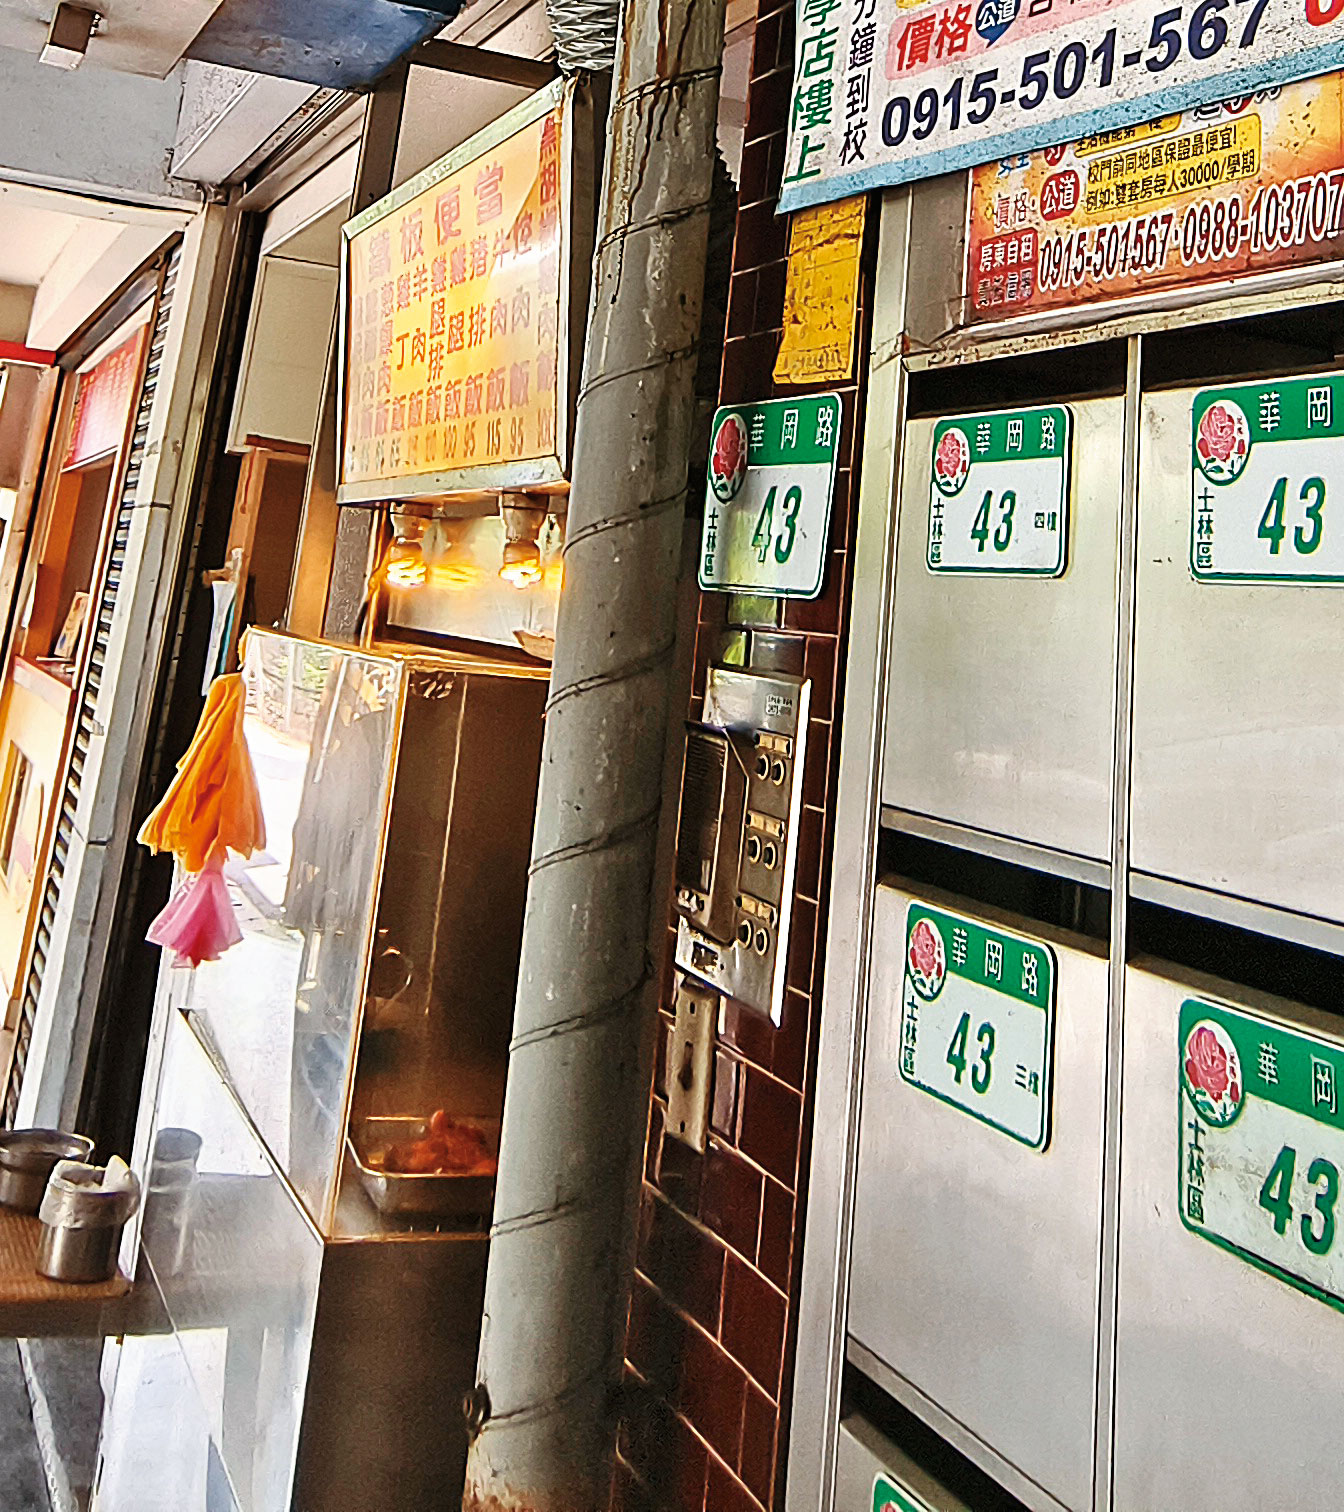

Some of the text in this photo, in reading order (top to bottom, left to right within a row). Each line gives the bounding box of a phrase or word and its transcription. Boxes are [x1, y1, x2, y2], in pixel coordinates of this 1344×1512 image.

[1043, 174, 1076, 215] 公道
[752, 485, 802, 564] 43
[970, 489, 1016, 552] 43
[1257, 476, 1326, 555] 43
[946, 1011, 995, 1094] 43
[1259, 1145, 1339, 1255] 43
